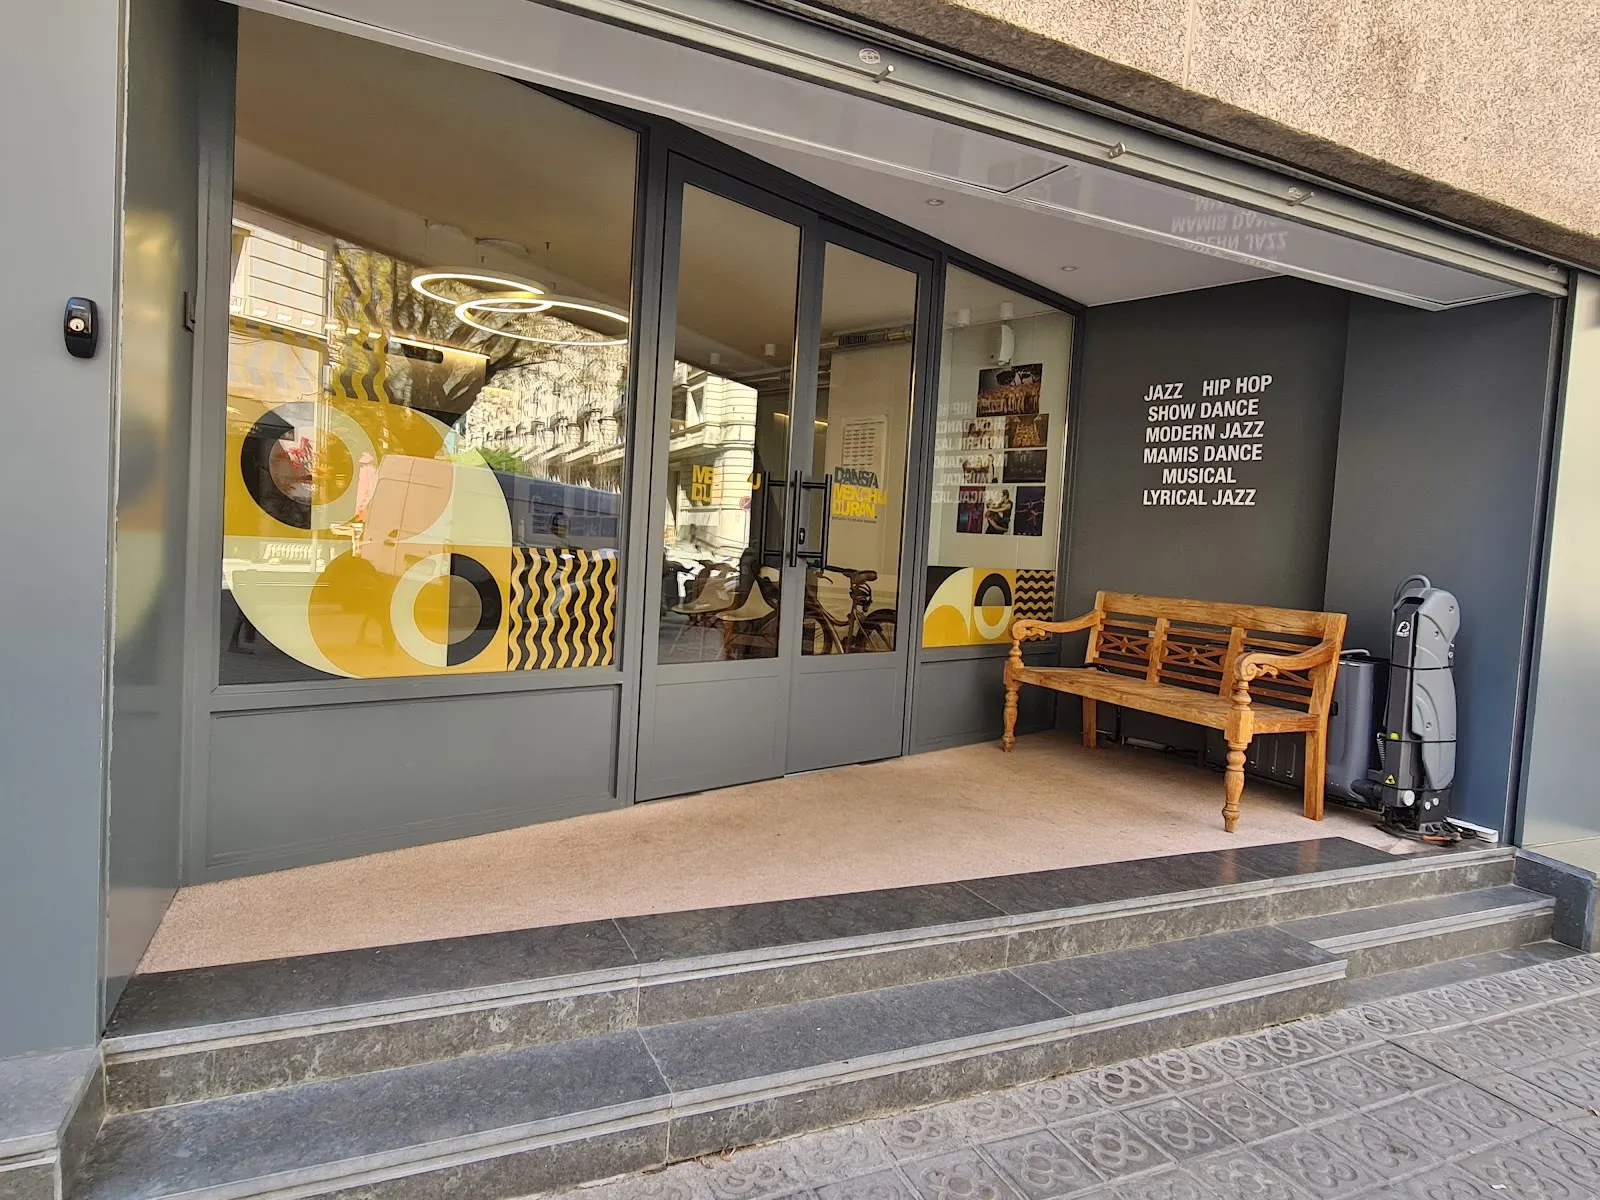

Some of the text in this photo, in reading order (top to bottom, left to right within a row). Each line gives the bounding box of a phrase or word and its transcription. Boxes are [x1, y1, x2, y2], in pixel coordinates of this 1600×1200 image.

[1144, 375, 1273, 401] JAZZ HIP HOP
[1148, 399, 1259, 421] SHOW DANCE
[1145, 421, 1265, 442] MODERN JAZZ
[1143, 443, 1263, 463] MAMIS DANCE
[834, 466, 879, 489] DANSA
[1162, 467, 1237, 484] MUSICAL
[1143, 489, 1256, 506] LYRICAL JAZZ
